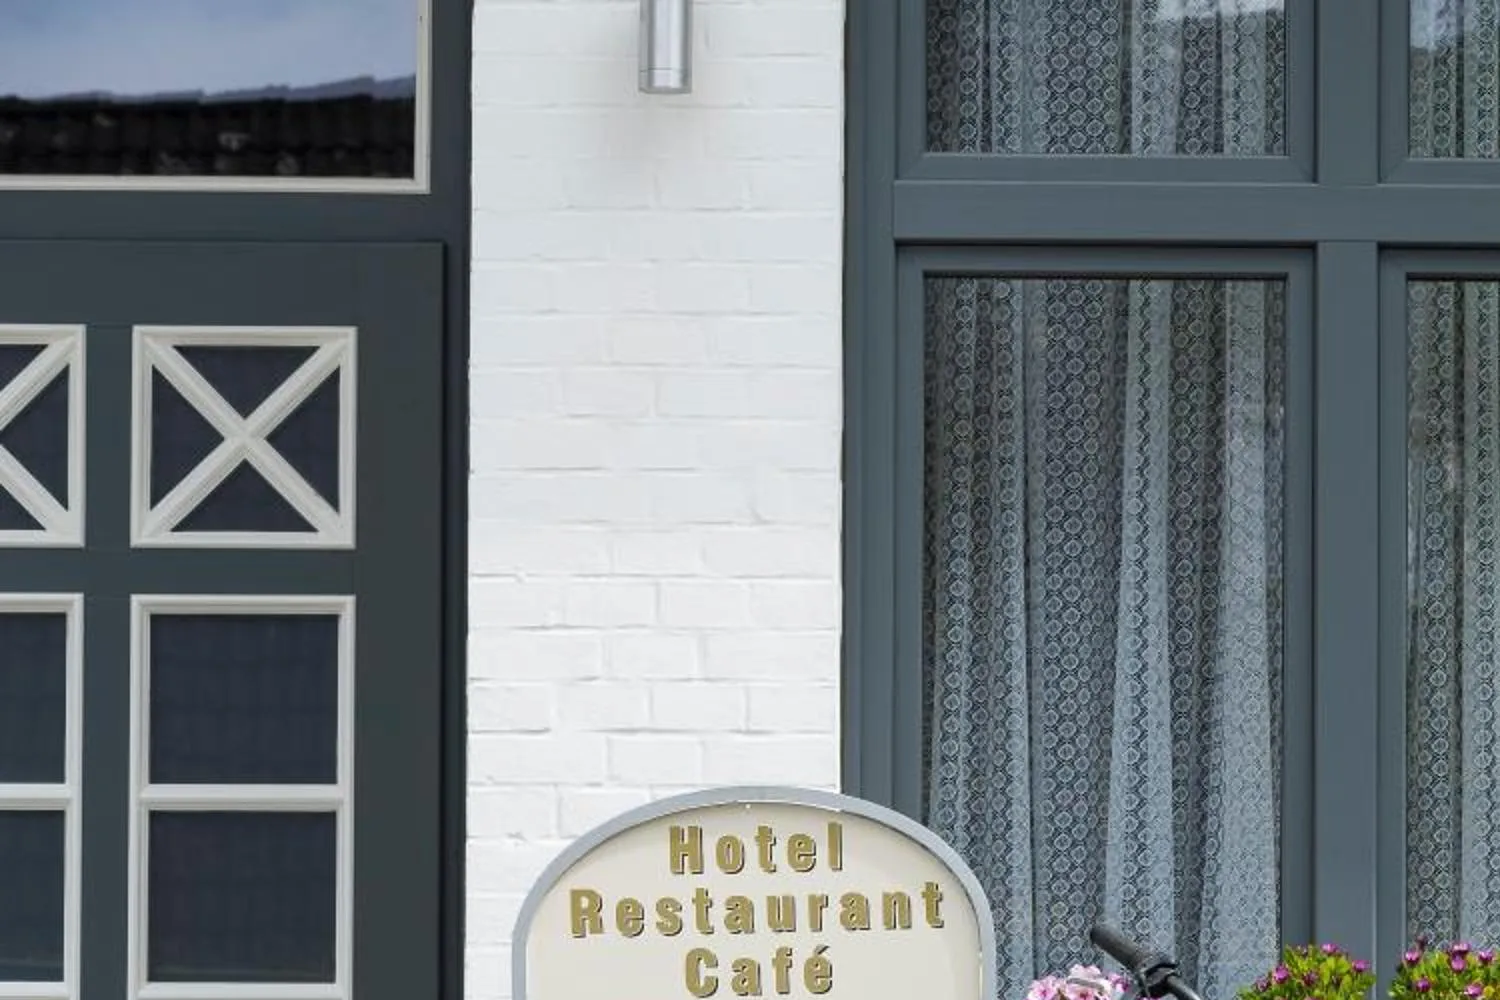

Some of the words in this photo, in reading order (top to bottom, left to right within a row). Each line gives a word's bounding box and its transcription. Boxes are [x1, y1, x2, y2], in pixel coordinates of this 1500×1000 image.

[668, 821, 843, 874] Hotel
[569, 882, 946, 938] Restaurant
[684, 945, 834, 998] Café
